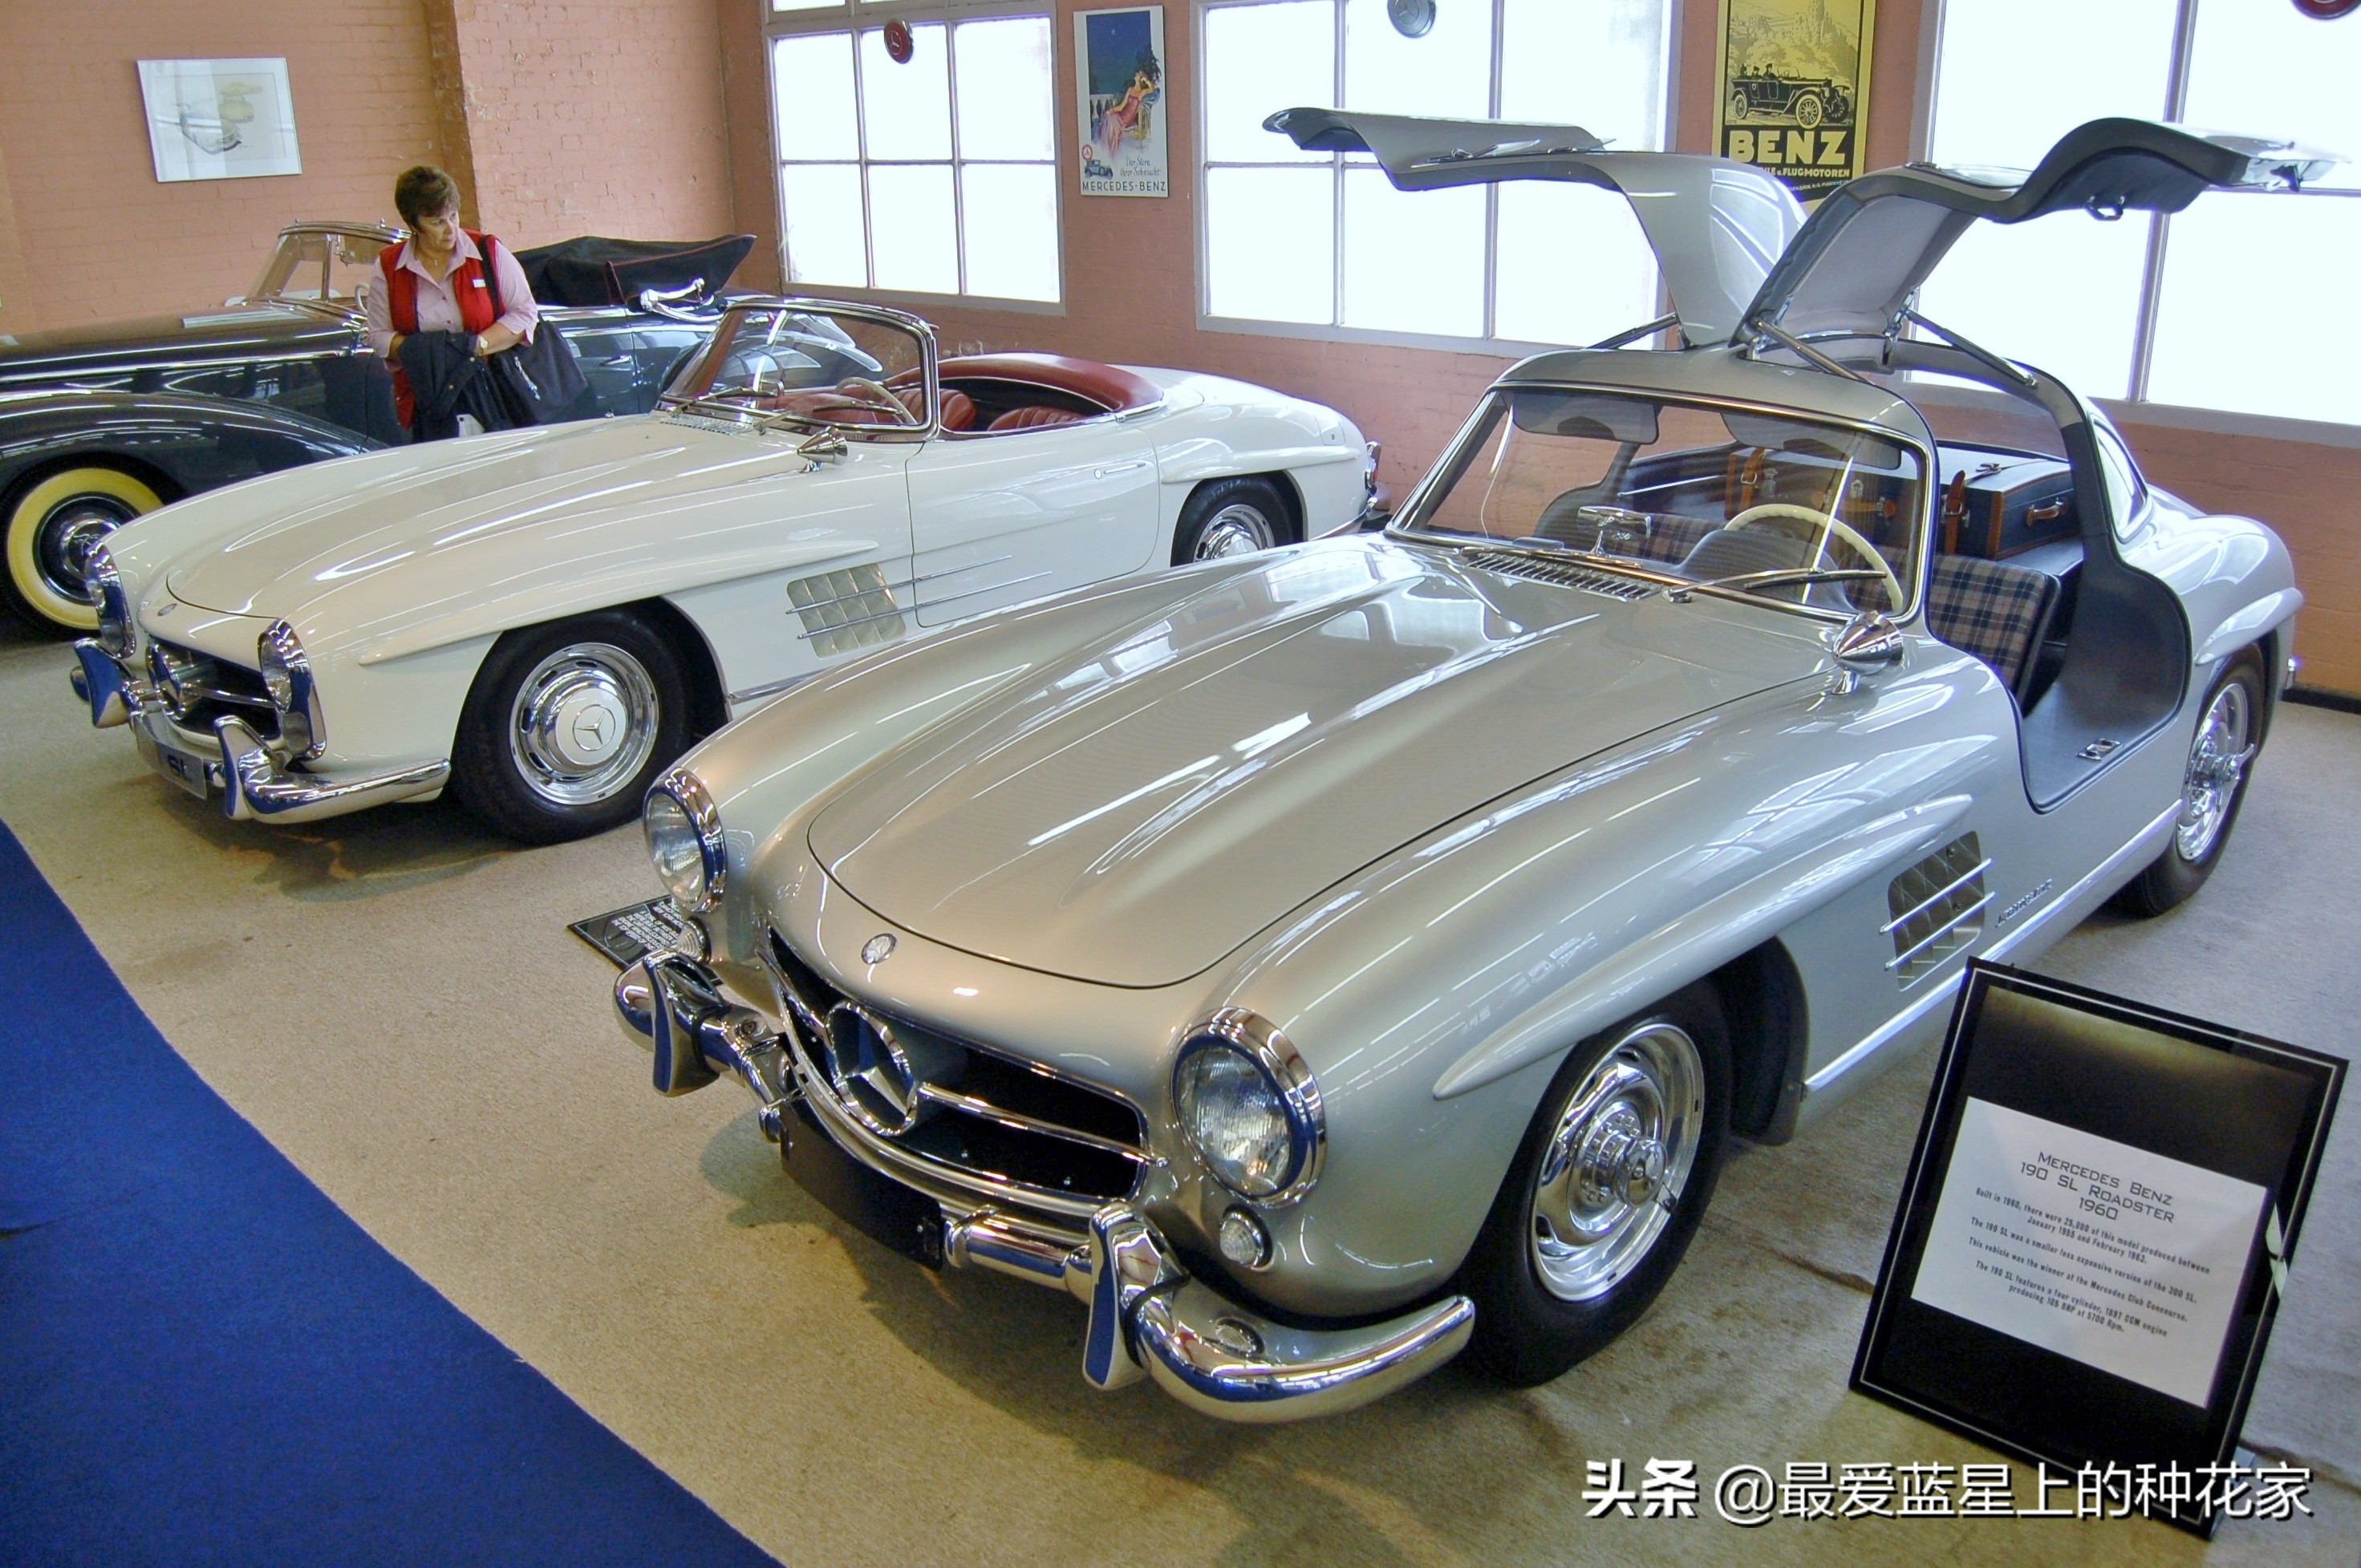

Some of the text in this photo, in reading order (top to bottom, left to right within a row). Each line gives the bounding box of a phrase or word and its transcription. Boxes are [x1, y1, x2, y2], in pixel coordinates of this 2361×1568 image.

[1728, 130, 1847, 165] BENZ
[1082, 181, 1166, 192] MERCEDES-BENZ
[1783, 167, 1850, 177] FLUGMOTOREN
[2021, 1161, 2175, 1224] 190 SL ROADSTER
[2037, 1151, 2173, 1206] MERCEDES BENZ
[2079, 1197, 2119, 1221] 1960
[1969, 1236, 1984, 1249] This
[1985, 1244, 2010, 1258] vehicle
[2011, 1254, 2025, 1264] was
[2026, 1258, 2038, 1269] the
[2040, 1264, 2065, 1278] winner
[2066, 1273, 2075, 1282] at
[2075, 1275, 2088, 1286] the
[2090, 1279, 2125, 1300] Mercedes
[2127, 1293, 2144, 1307] Club
[1971, 1216, 1984, 1228] The
[1999, 1226, 2008, 1238] SL
[2010, 1232, 2024, 1242] was
[2031, 1240, 2059, 1254] smaller
[2059, 1247, 2075, 1261] less
[2076, 1255, 2112, 1274] expensive
[2114, 1269, 2142, 1284] version
[2143, 1278, 2153, 1287] of
[2153, 1281, 2167, 1293] the
